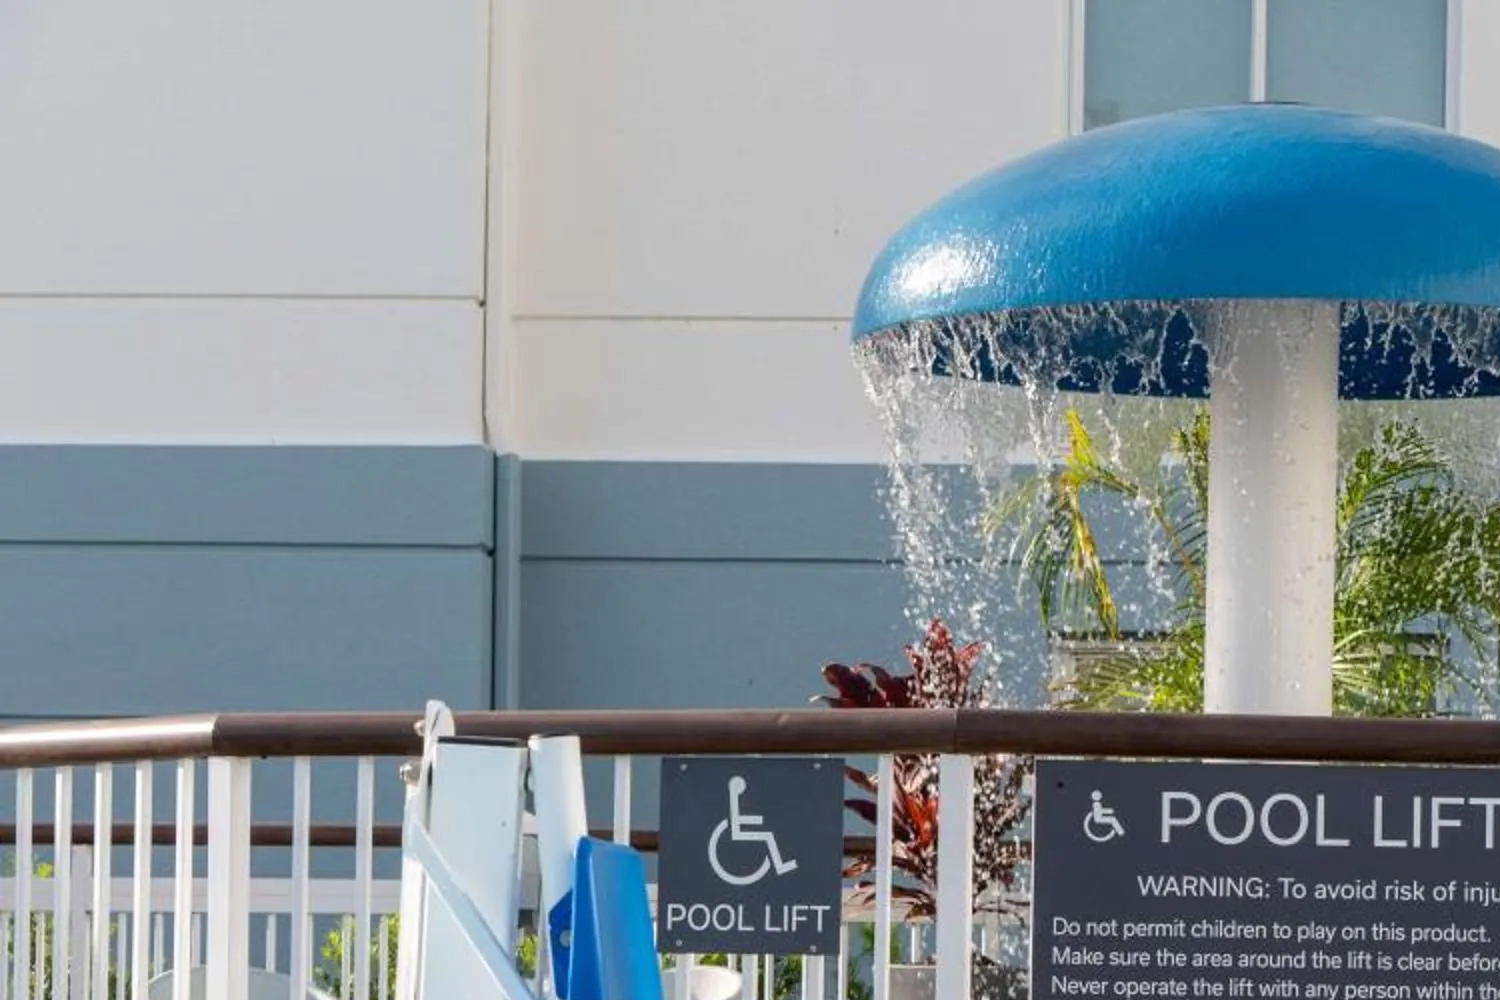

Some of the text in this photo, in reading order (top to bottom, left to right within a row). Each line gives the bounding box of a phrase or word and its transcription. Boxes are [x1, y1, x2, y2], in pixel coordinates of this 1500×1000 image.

[1160, 791, 1351, 847] POOL
[1136, 875, 1270, 899] WARNING:
[1277, 877, 1307, 900] To
[1314, 879, 1378, 901] avoid
[1384, 879, 1425, 902] risk
[1432, 880, 1457, 902] of
[666, 903, 830, 933] POOL LIFT
[1052, 916, 1492, 945] Do not permit children to play on this product.
[1052, 945, 1105, 966] Make
[1108, 950, 1151, 967] sure
[1156, 947, 1188, 968] the
[1191, 952, 1233, 968] area
[1237, 949, 1306, 969] around
[1310, 949, 1343, 970] the
[1347, 950, 1373, 970] lift
[1377, 951, 1393, 971] is
[1396, 951, 1444, 971] clear
[1051, 975, 1109, 995] Never
[1113, 978, 1188, 999] operate
[1192, 977, 1224, 997] the
[1228, 977, 1254, 997] lift
[1258, 978, 1300, 998] with
[1415, 980, 1474, 1000] within
